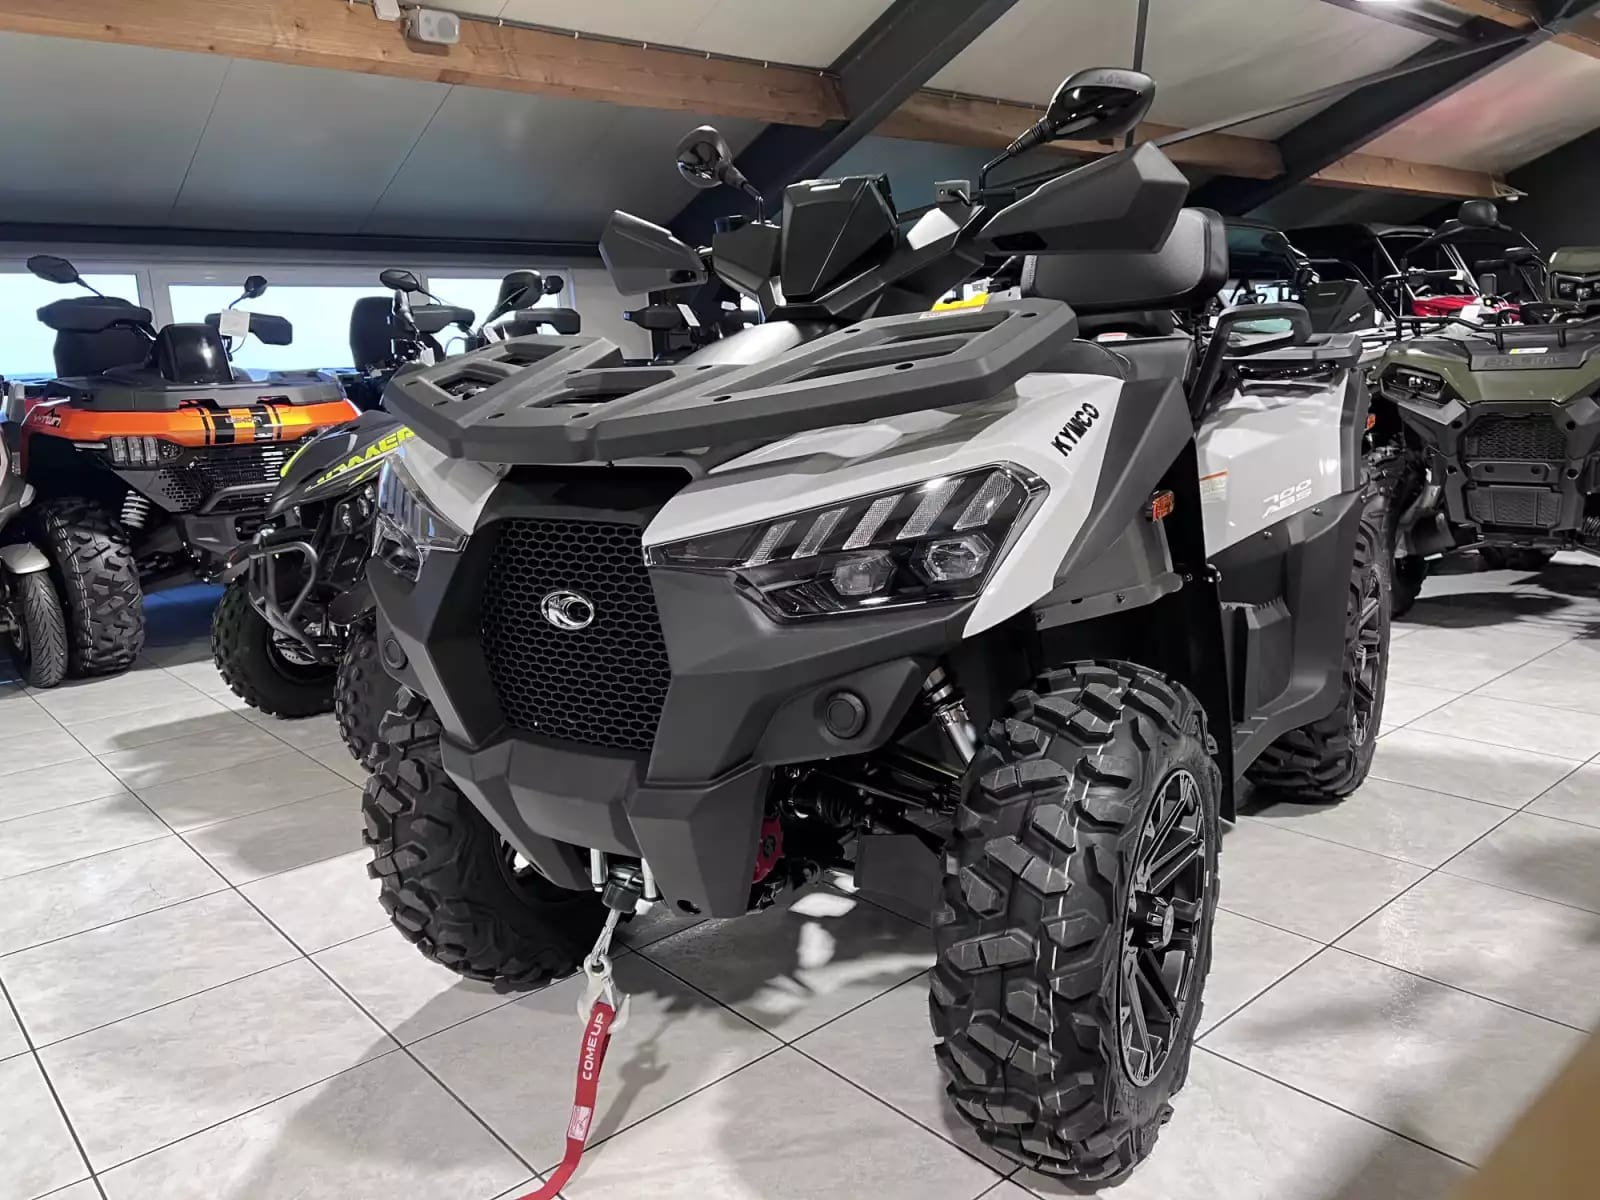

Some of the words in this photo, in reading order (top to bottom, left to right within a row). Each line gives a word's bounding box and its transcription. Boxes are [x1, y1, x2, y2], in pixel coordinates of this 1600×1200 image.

[1050, 402, 1100, 457] KYMCO
[1263, 478, 1312, 504] 700
[582, 1012, 604, 1081] COMEUP
